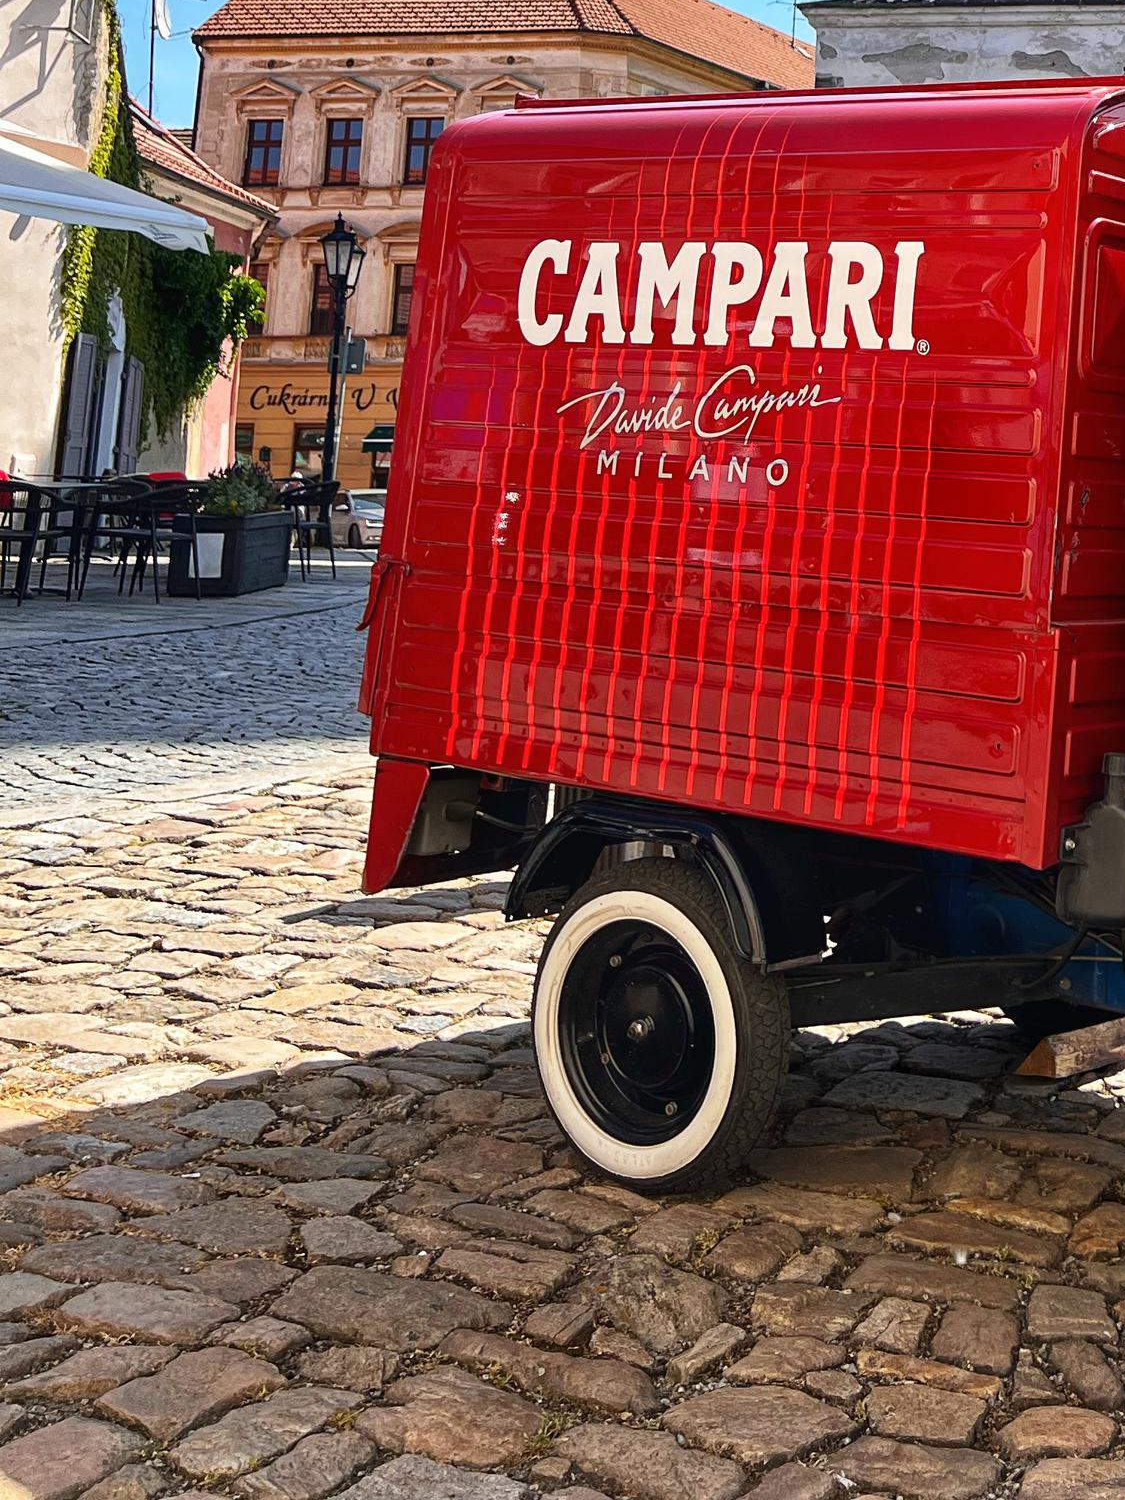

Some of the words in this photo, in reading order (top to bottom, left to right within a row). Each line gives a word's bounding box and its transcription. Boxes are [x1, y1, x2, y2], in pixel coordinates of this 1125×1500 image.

[250, 383, 338, 415] Cukrárn
[352, 383, 376, 411] U
[556, 381, 691, 449] Davide
[694, 364, 841, 445] Campari
[596, 449, 789, 486] MILANO
